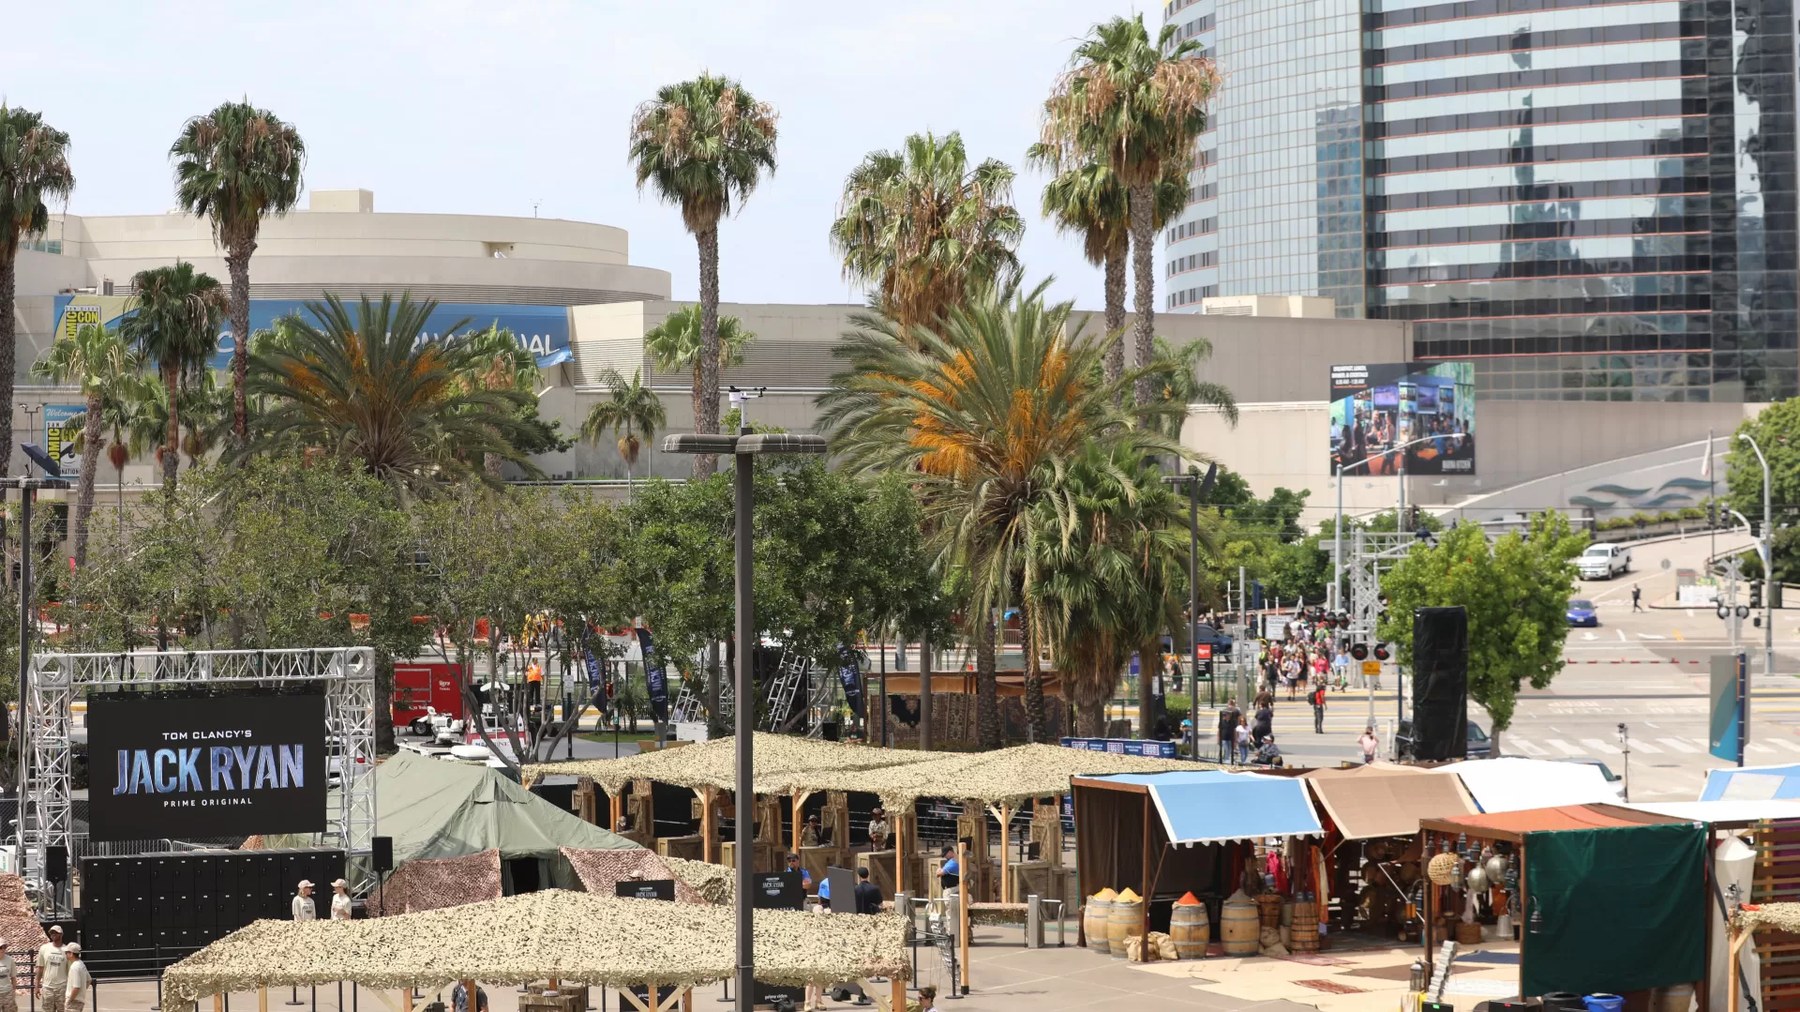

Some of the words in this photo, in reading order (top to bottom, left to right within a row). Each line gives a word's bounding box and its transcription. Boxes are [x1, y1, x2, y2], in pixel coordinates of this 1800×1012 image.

[77, 311, 98, 323] CON
[47, 408, 77, 417] Welcome
[162, 731, 188, 741] TOM
[192, 729, 253, 740] CLANCY'S
[112, 747, 204, 796] JACK
[209, 743, 305, 792] RYAN
[163, 799, 197, 808] PRIME
[201, 797, 253, 807] ORIGINAL
